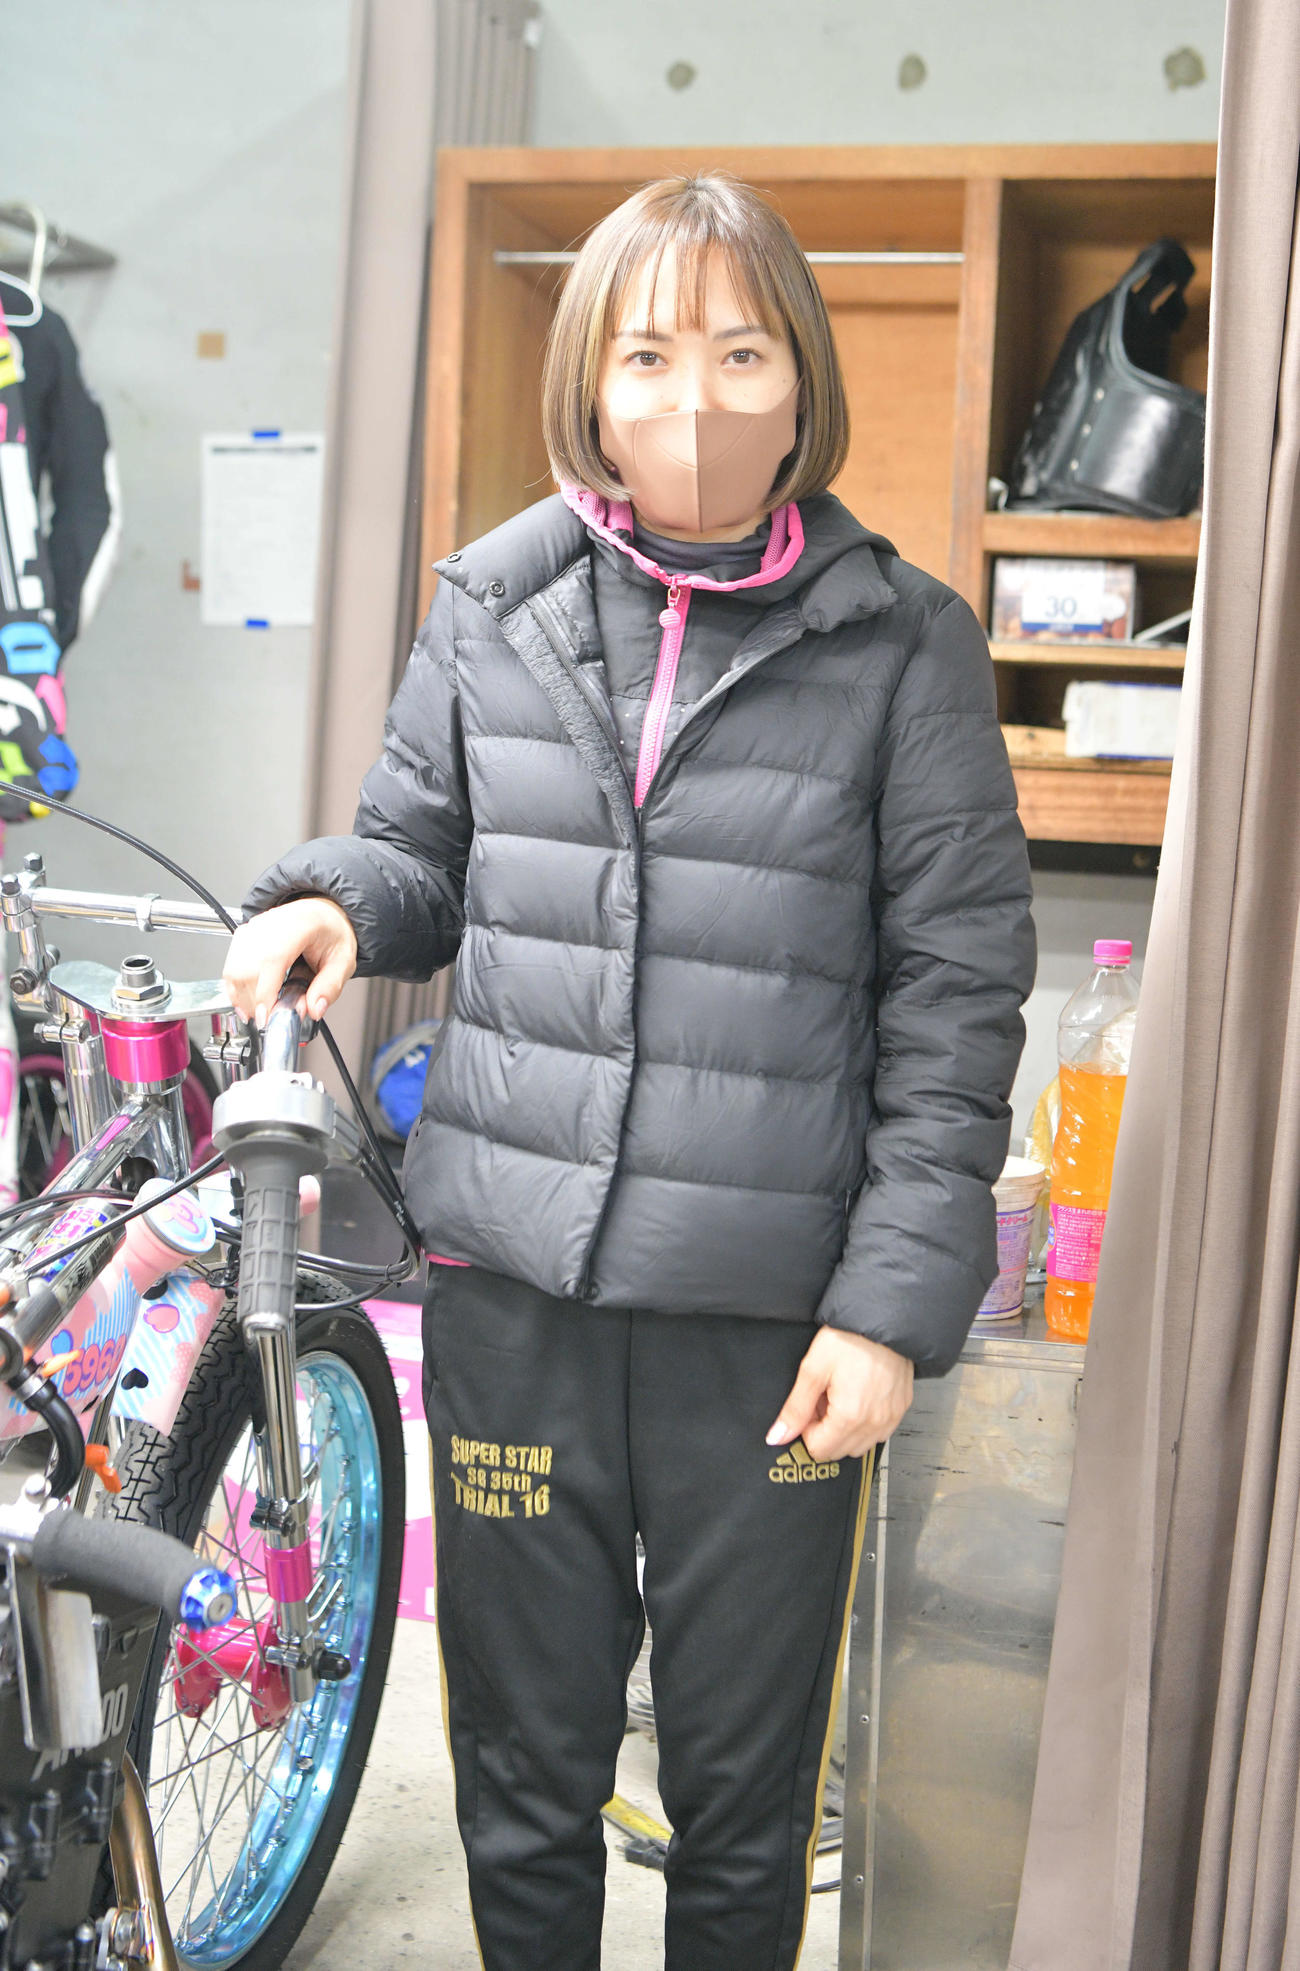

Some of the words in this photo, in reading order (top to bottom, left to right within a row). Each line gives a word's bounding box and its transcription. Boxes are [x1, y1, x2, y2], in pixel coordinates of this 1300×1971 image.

[1045, 596, 1078, 618] 30
[451, 1434, 500, 1467] SUPER
[505, 1445, 553, 1476] STAR
[490, 1470, 532, 1492] 35th
[768, 1461, 840, 1484] adidas
[451, 1471, 515, 1519] TRIAL
[519, 1483, 550, 1519] 16
